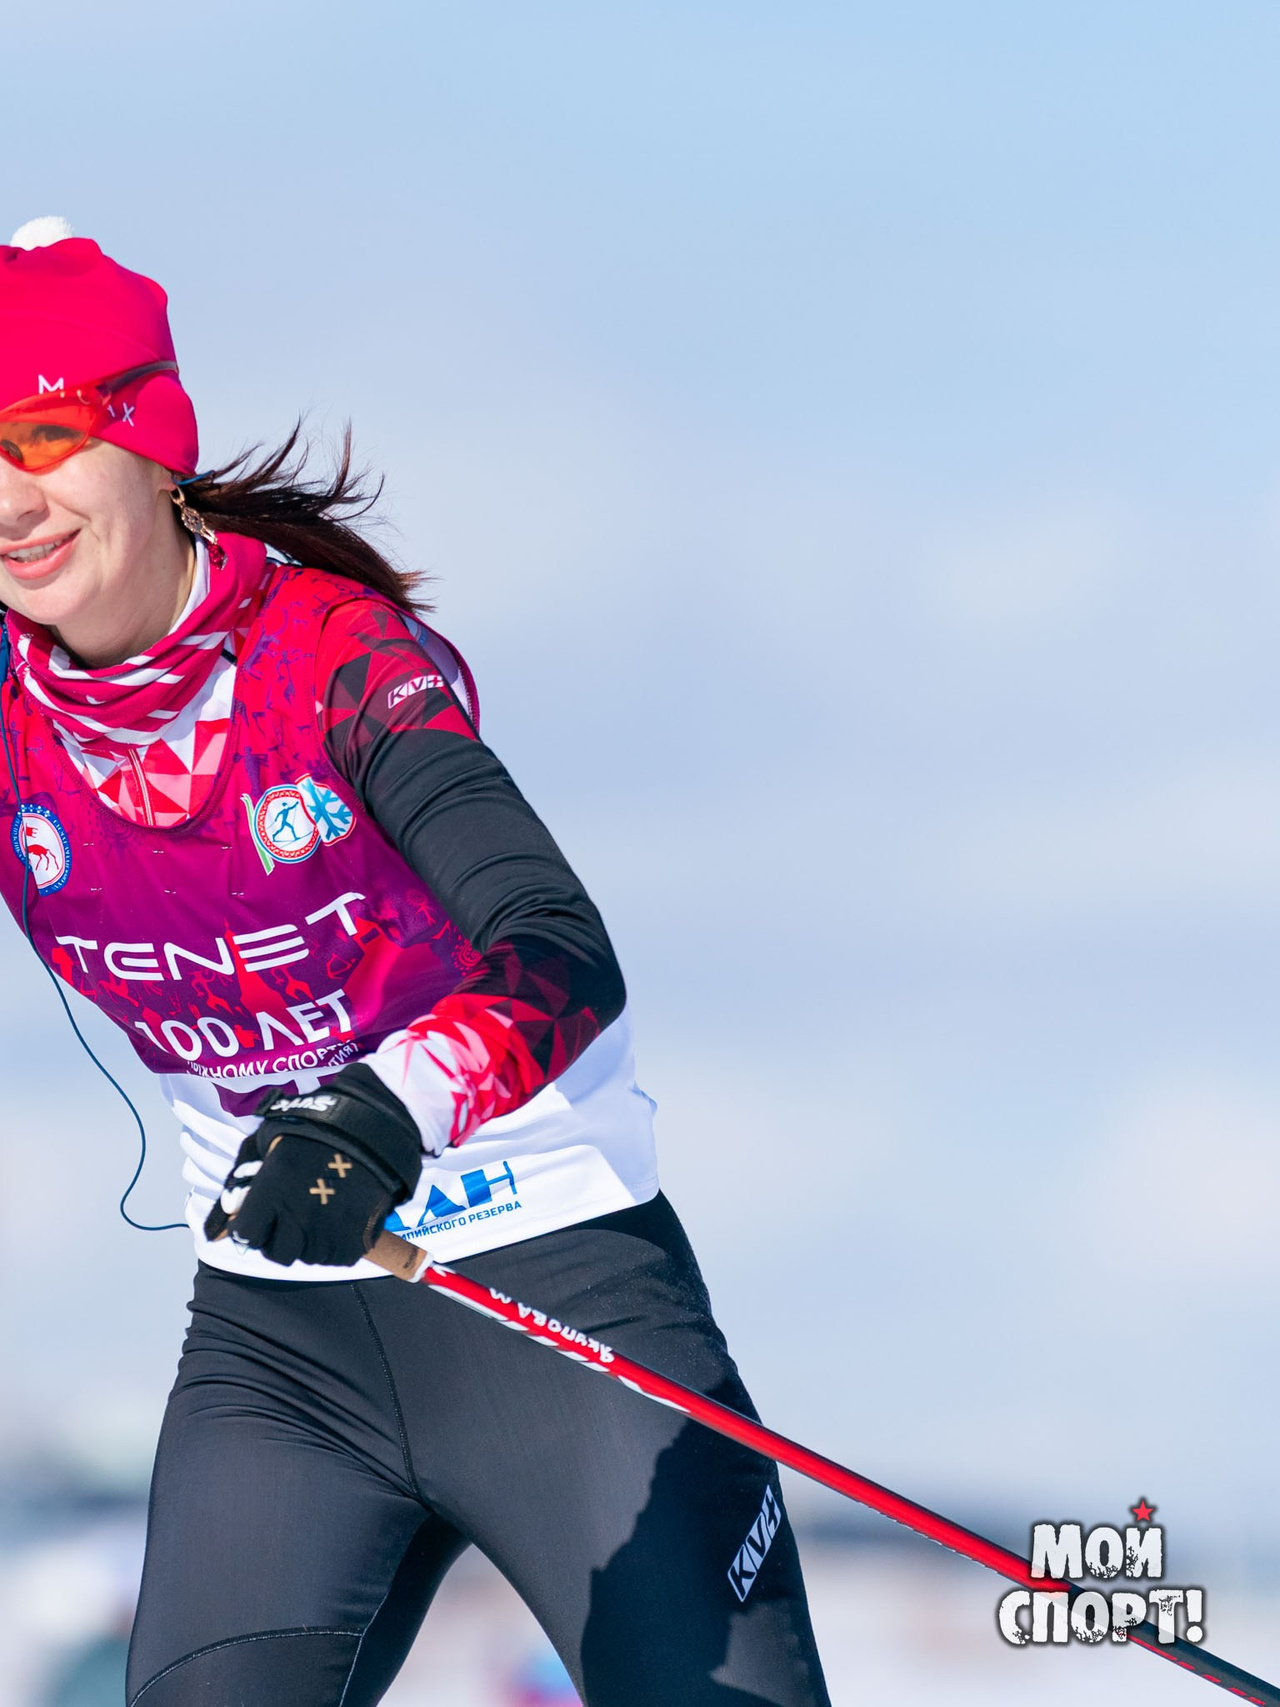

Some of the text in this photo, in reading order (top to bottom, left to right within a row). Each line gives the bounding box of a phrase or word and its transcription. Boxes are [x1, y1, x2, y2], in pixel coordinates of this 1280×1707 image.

[56, 891, 367, 981] TENET
[134, 988, 352, 1062] 100 ЛЕТ
[468, 1200, 522, 1223] РЕЗЕРВА
